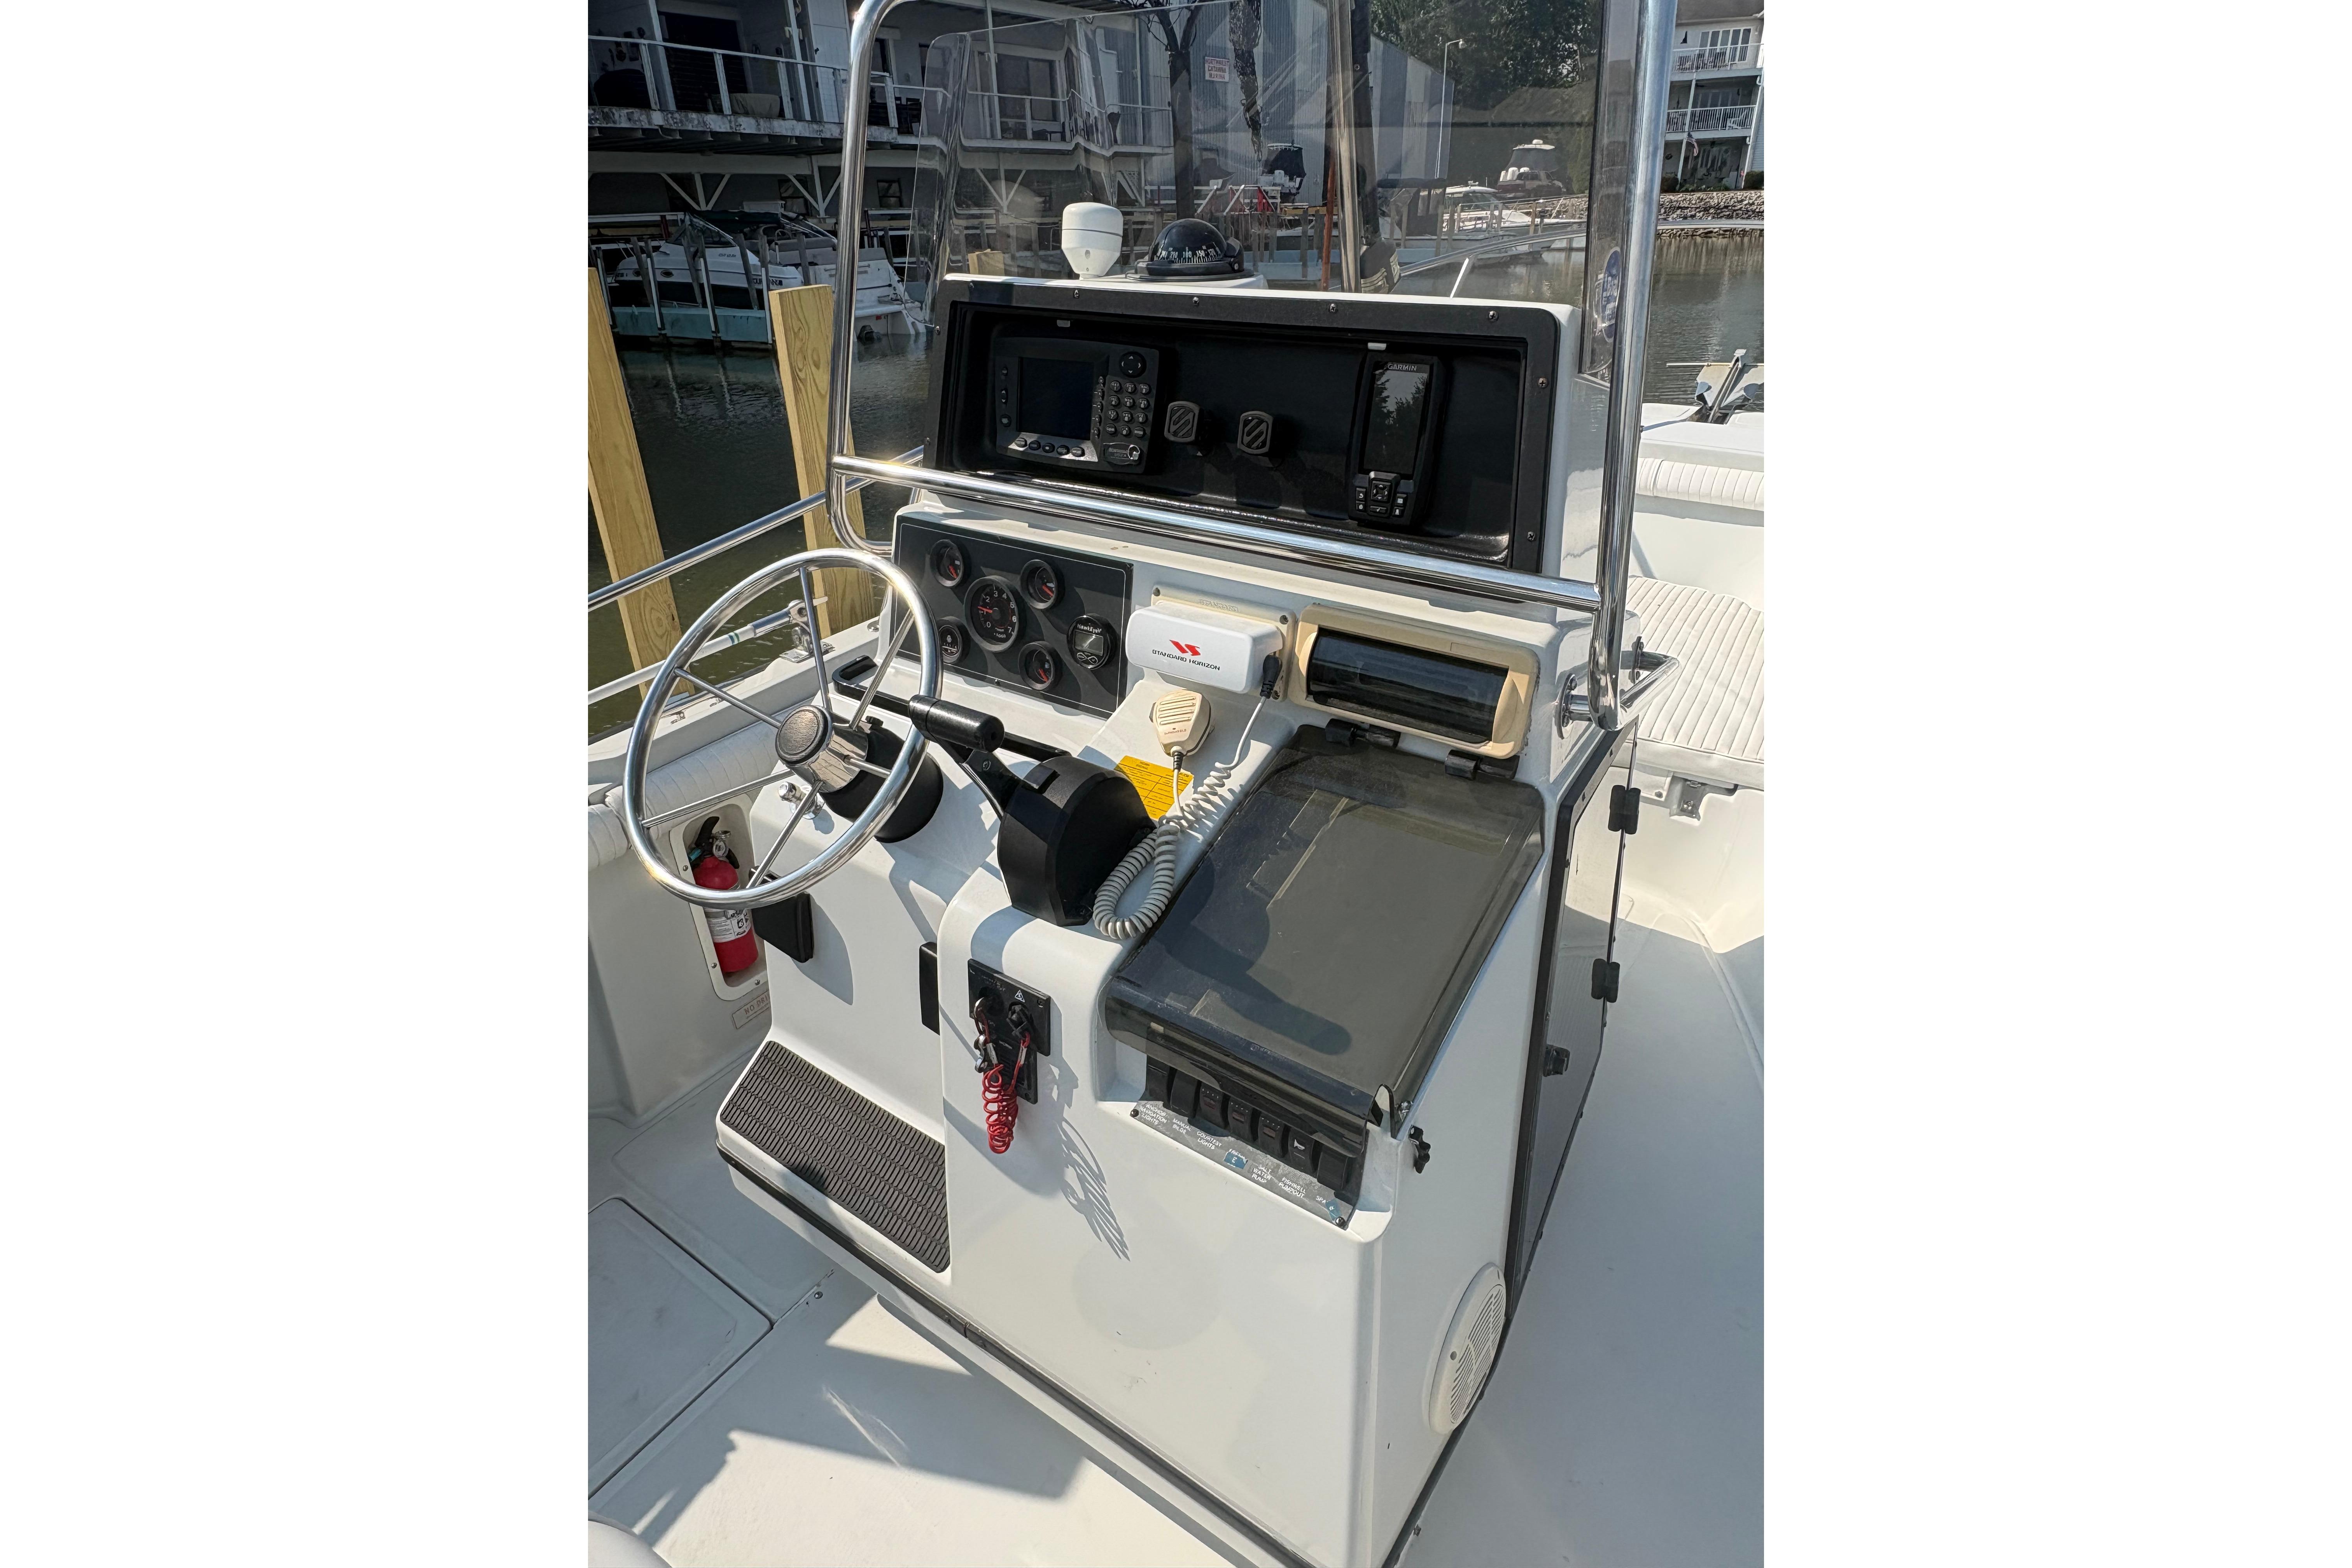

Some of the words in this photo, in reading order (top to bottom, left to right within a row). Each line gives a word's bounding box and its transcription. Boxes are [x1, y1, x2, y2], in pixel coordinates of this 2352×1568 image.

[1152, 649, 1187, 662] STANDARD
[1189, 658, 1220, 671] HORIZON
[744, 1004, 754, 1015] NO
[1197, 1131, 1222, 1147] COURTESY
